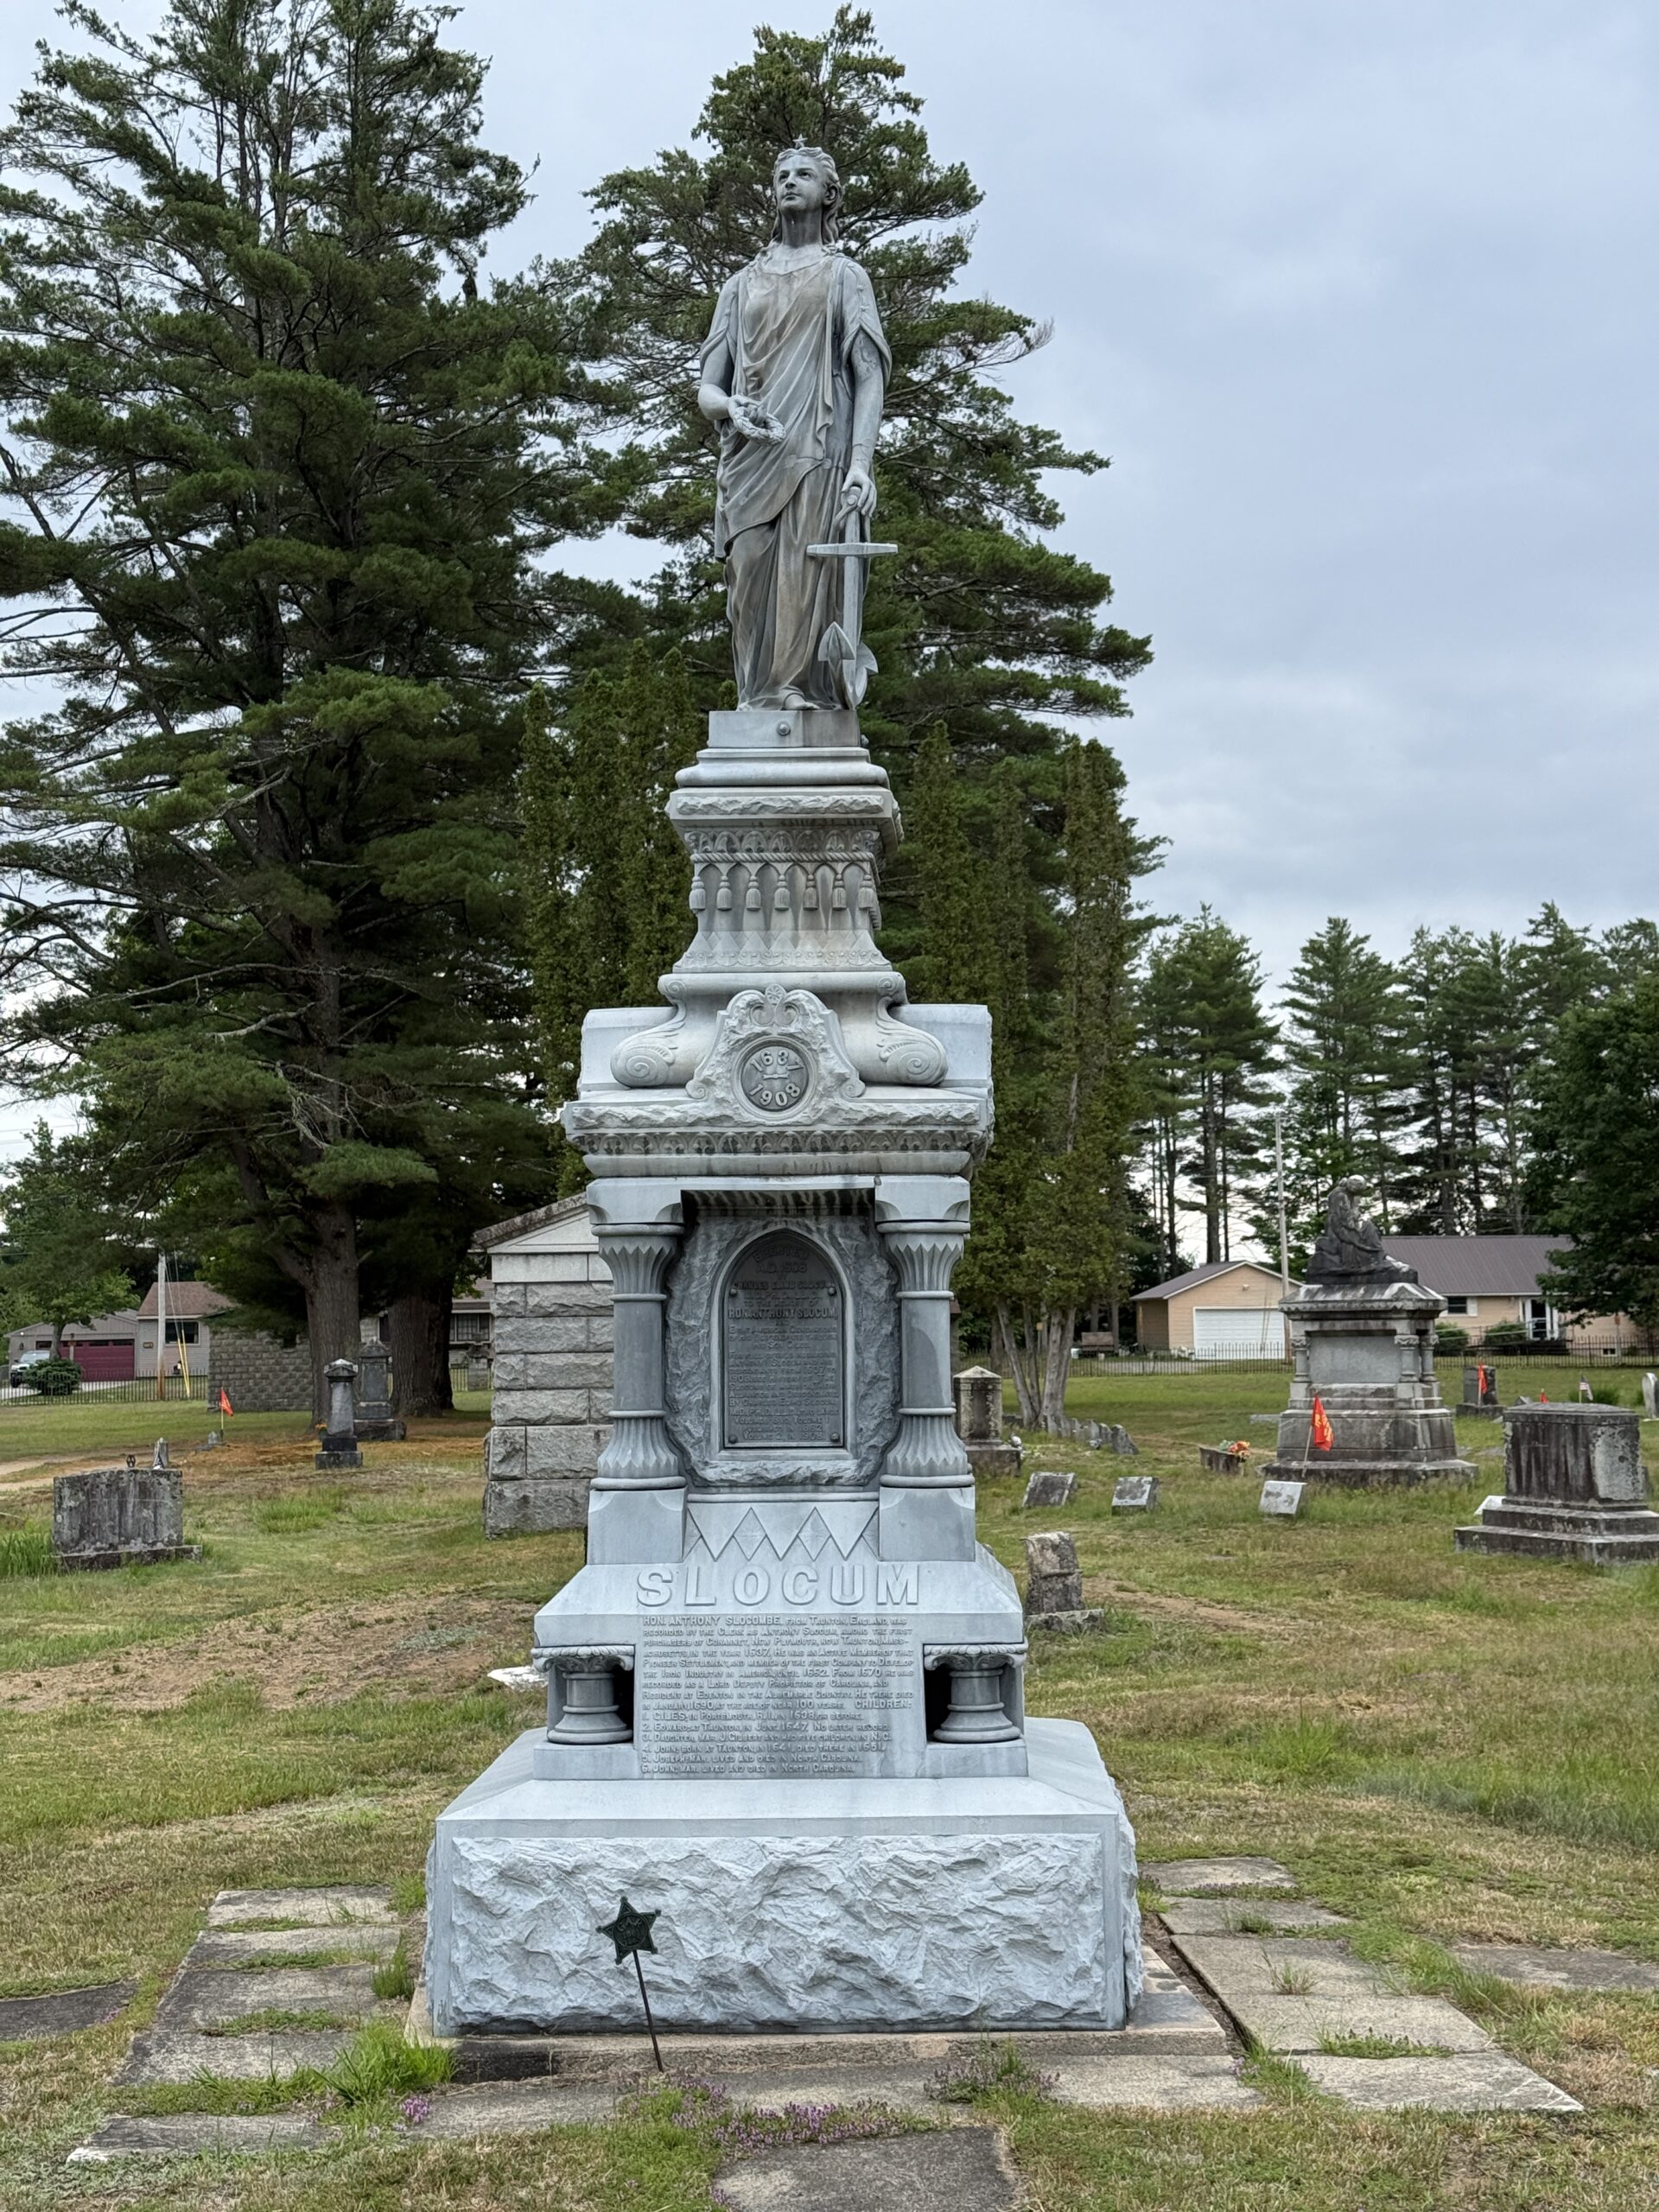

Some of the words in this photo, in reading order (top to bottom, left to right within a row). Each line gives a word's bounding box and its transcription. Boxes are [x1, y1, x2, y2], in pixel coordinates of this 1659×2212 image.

[751, 1049, 804, 1074] 1637
[749, 1083, 802, 1107] 1908
[637, 1565, 919, 1607] SLOCUM
[643, 1615, 667, 1625] HON.
[669, 1615, 721, 1625] ANTHONY
[890, 1617, 907, 1625] WAS
[760, 1627, 802, 1636] ANTHONY
[752, 1637, 772, 1646] NEW
[642, 1658, 677, 1668] PIONEER
[830, 1657, 867, 1667] COMPANY
[878, 1656, 914, 1667] DEVELOP
[661, 1669, 682, 1678] IRON
[685, 1669, 724, 1678] INDUSTRY
[831, 1668, 855, 1677] FROM
[708, 1679, 730, 1688] LORD
[734, 1679, 766, 1688] DEPUTY
[642, 1690, 682, 1700] RESIDENT
[696, 1690, 734, 1700] EDENTON
[855, 1689, 868, 1699] HE
[796, 1700, 815, 1709] 100
[642, 1722, 652, 1732] 2.
[813, 1721, 826, 1732] NO
[641, 1733, 652, 1743] 3.
[728, 1732, 763, 1742] GILBERT
[871, 1732, 880, 1741] N.
[882, 1732, 892, 1741] C.
[711, 1754, 735, 1763] LIVED
[739, 1754, 754, 1763] AND
[791, 1752, 818, 1762] NORTH
[641, 1764, 652, 1773] 6.
[747, 1764, 766, 1772] DIED
[781, 1763, 809, 1772] NORTH
